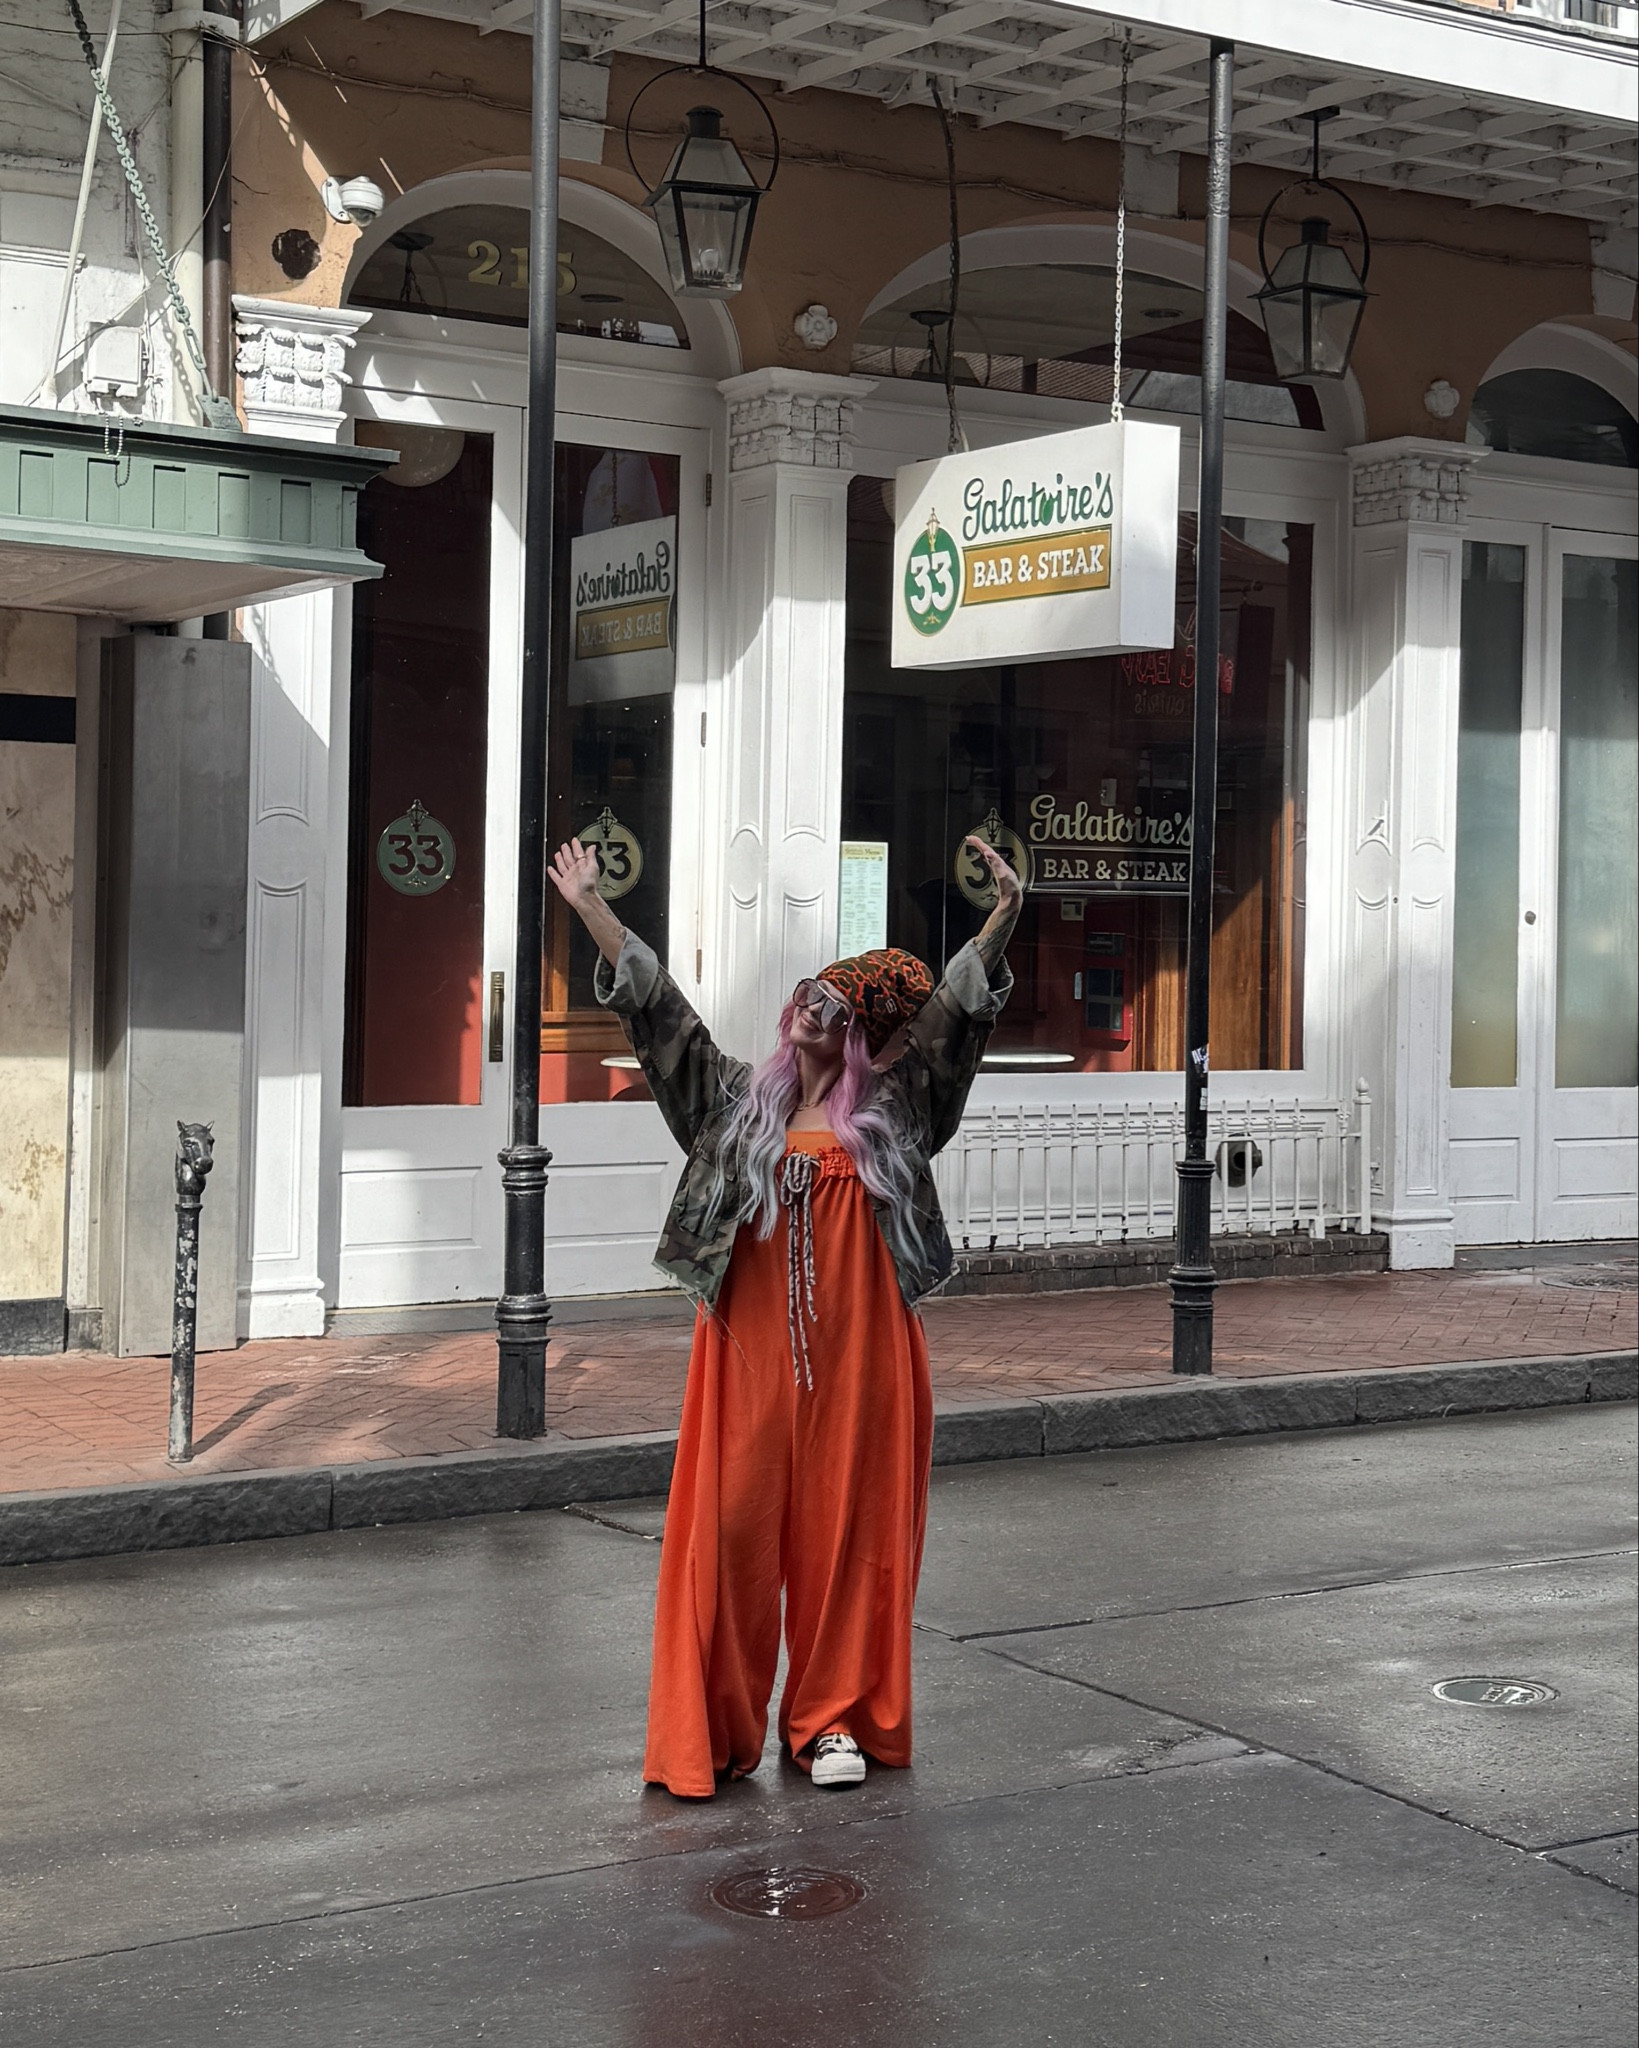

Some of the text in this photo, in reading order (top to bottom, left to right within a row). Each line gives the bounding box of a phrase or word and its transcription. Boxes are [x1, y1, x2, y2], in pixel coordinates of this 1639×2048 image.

[467, 240, 577, 296] 215
[962, 472, 1114, 541] Galatoire's
[910, 551, 954, 615] 33
[973, 544, 1105, 588] BAR & STEAK
[1029, 794, 1192, 846] Galatoire's
[388, 834, 444, 876] 33
[1043, 859, 1187, 881] BAR & STEAK
